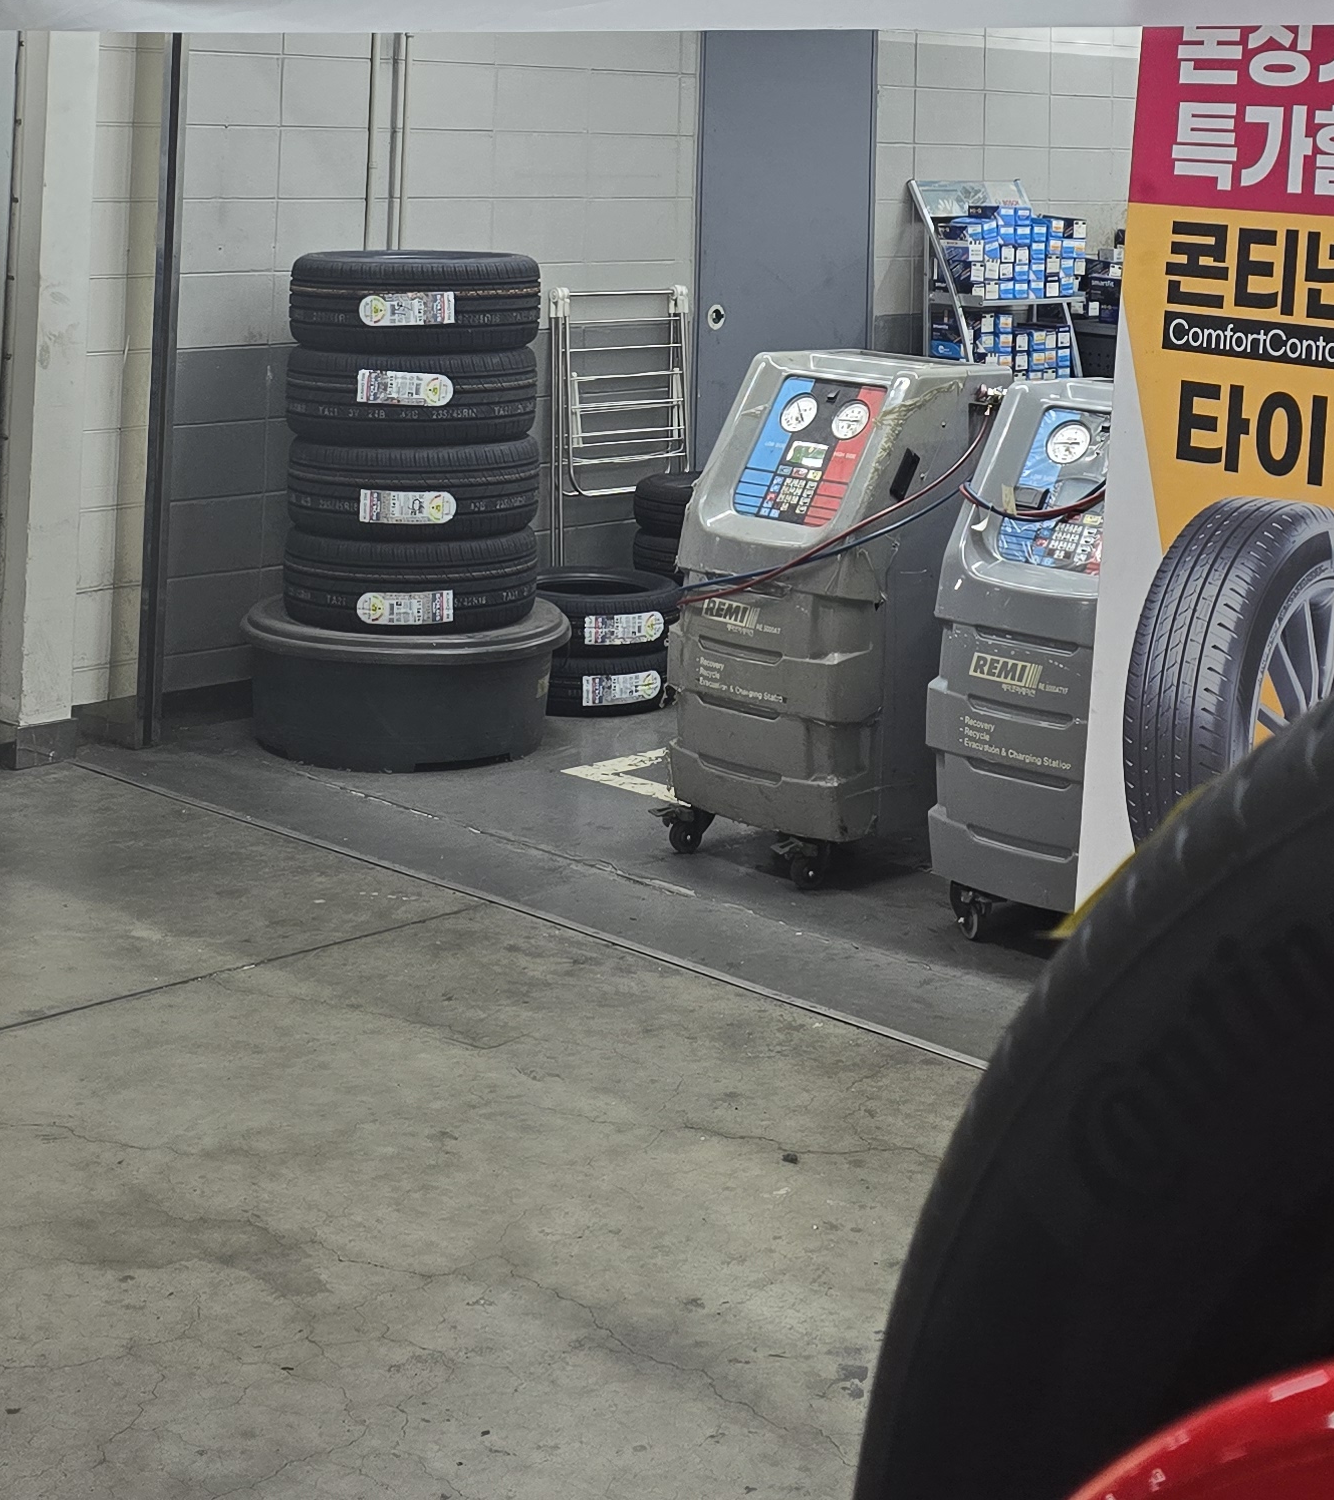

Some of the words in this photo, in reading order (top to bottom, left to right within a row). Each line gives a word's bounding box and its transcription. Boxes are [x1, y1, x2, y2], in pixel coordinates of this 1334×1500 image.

[704, 599, 749, 626] REMI
[972, 654, 1030, 684] REMI
[964, 715, 996, 733] Recovery
[964, 726, 990, 742] Recycle
[1008, 749, 1042, 766] Charging
